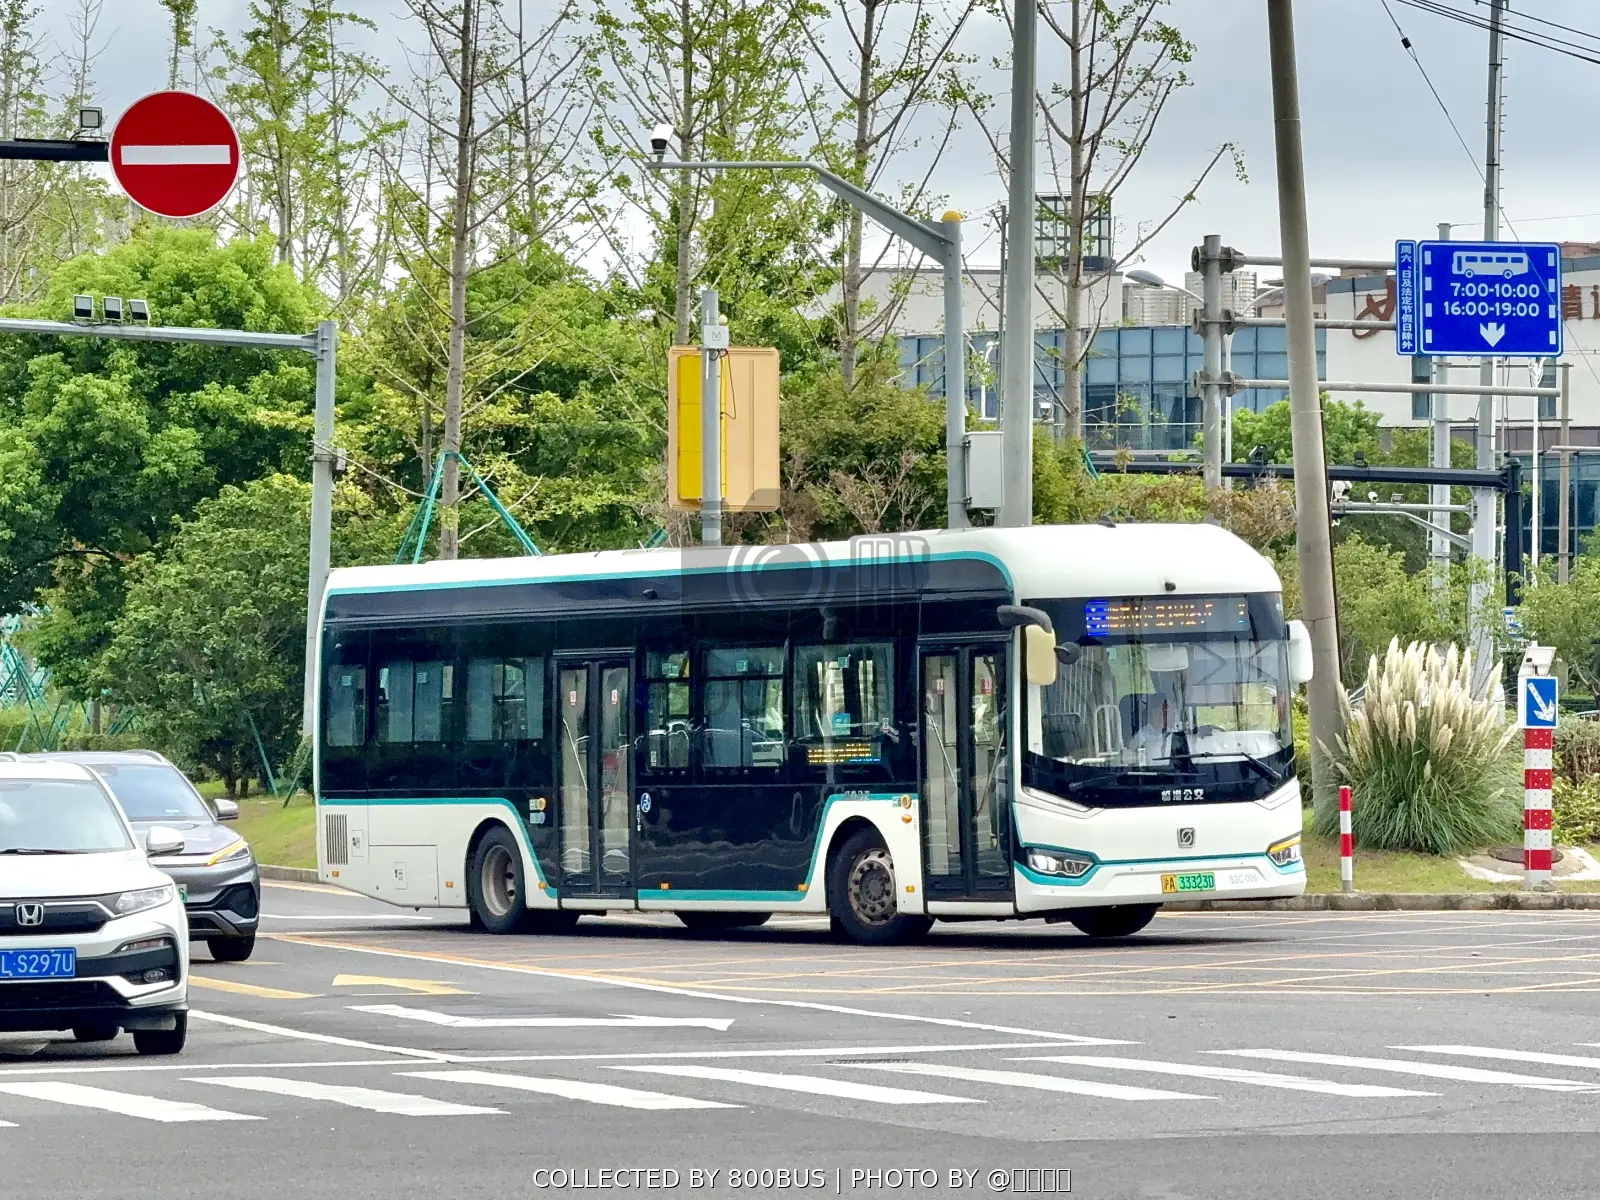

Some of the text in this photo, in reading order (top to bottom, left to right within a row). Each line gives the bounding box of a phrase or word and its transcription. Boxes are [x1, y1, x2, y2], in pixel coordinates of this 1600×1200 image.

[1400, 245, 1413, 350] 周六、日及法定节假日除外
[1450, 282, 1540, 298] 7:00-10:00
[1443, 301, 1540, 317] 16:00-19:00
